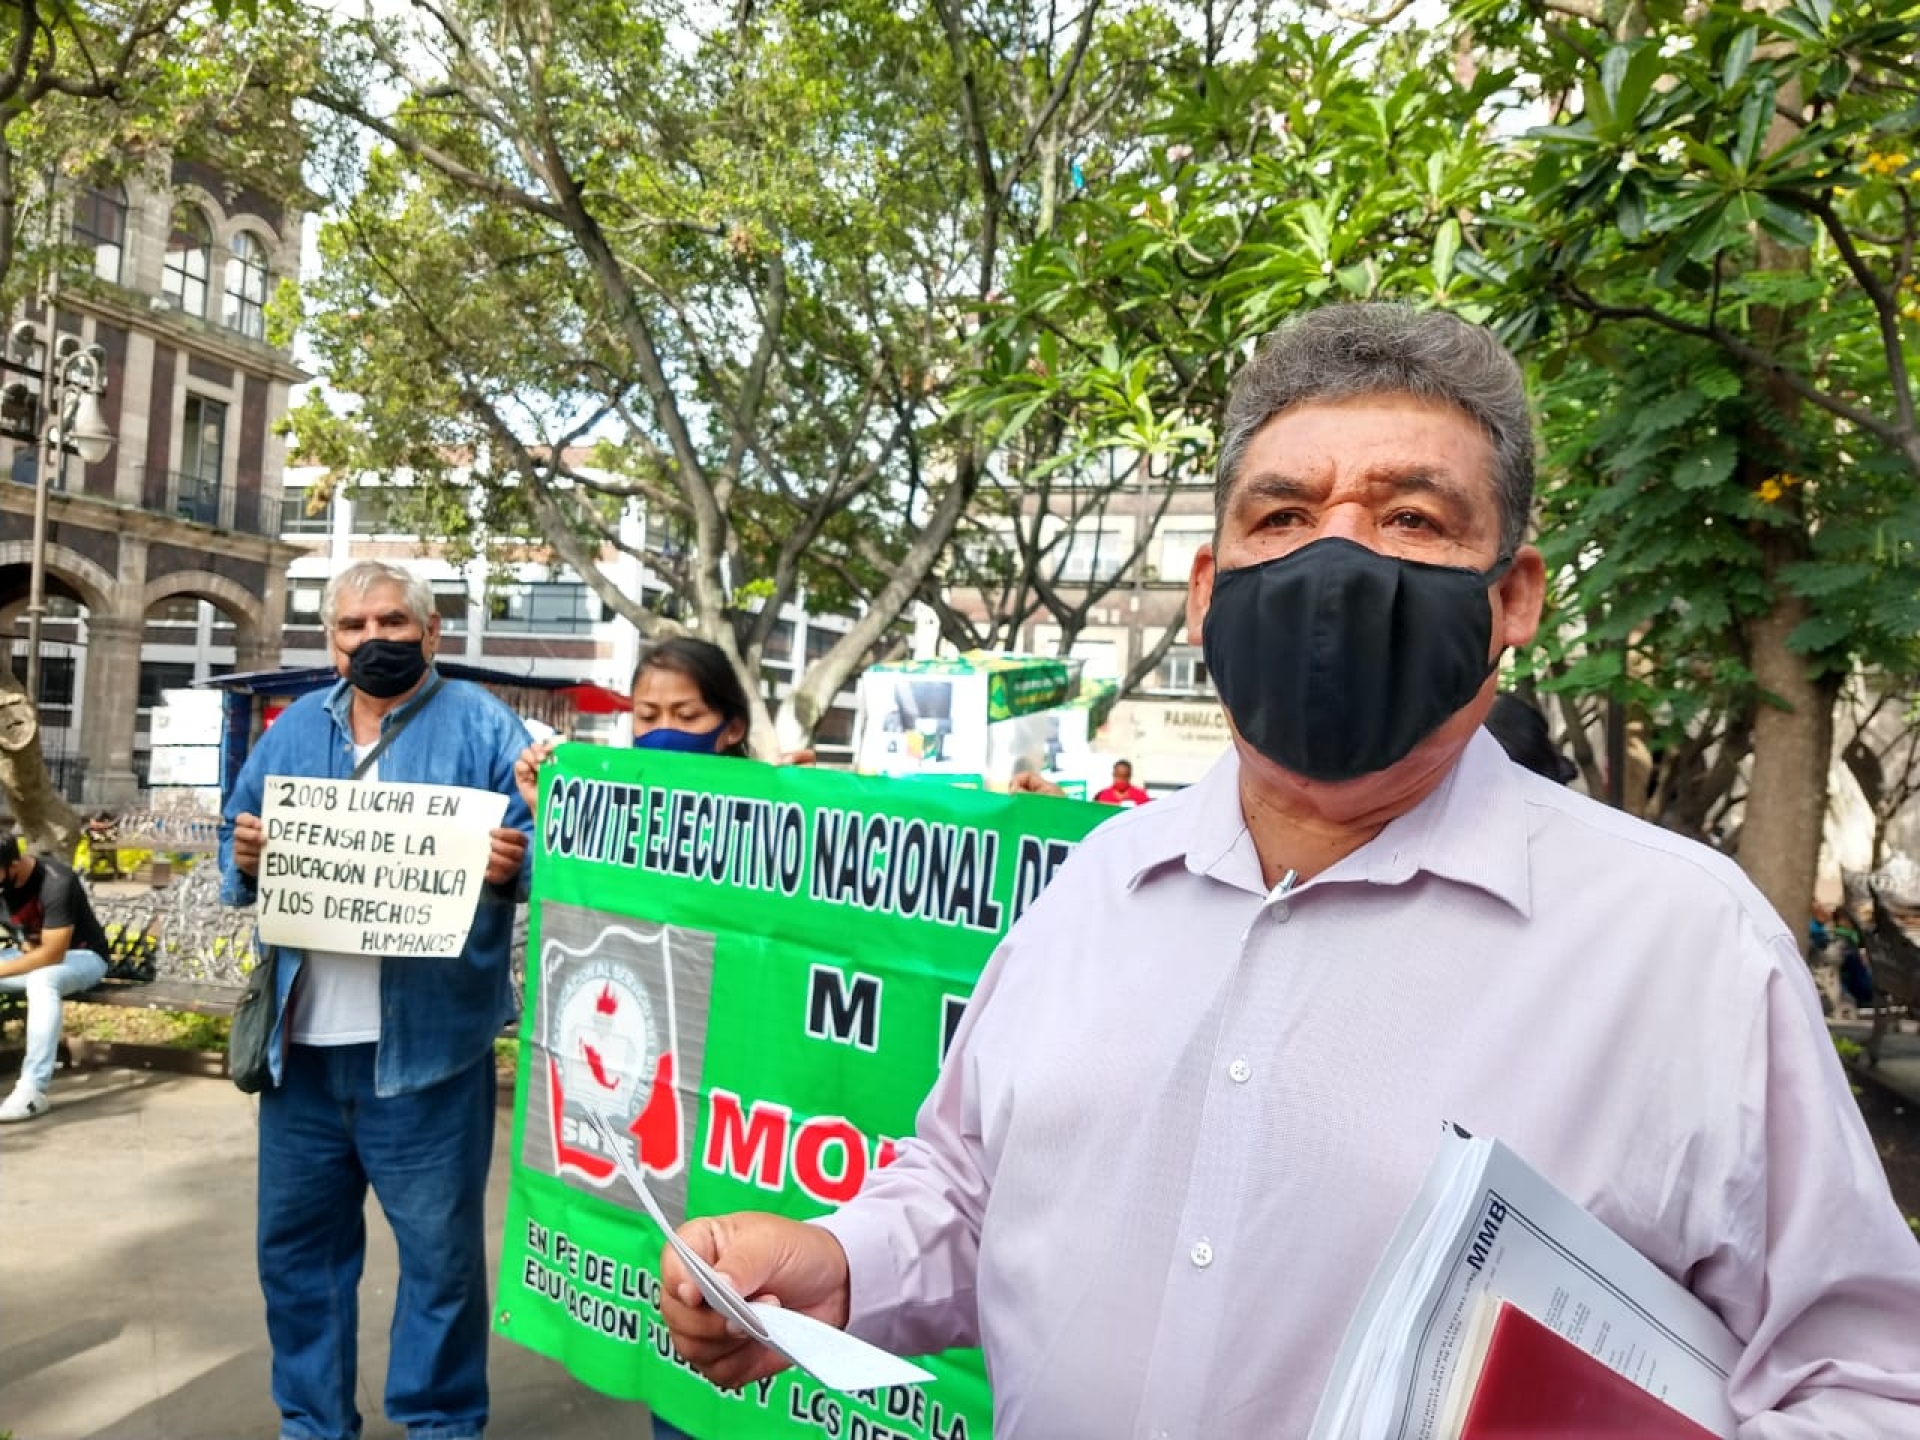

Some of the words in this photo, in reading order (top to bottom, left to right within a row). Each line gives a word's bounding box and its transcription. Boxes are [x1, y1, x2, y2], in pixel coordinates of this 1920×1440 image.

[347, 786, 415, 814] LUCHA
[426, 795, 462, 817] EN
[265, 851, 366, 885] EDUCACIÓN
[373, 861, 468, 897] PÚBLICA
[404, 834, 436, 856] LA
[546, 774, 642, 868] COMITE
[643, 787, 805, 896] EJECUTIVO
[810, 806, 1002, 933] NACIONAL
[260, 887, 274, 916] Y
[278, 890, 314, 915] LOS
[323, 895, 433, 926] DERECHOS
[703, 1087, 898, 1204] MO
[1466, 1198, 1507, 1271] MMB
[523, 1255, 641, 1343] EDUACION
[527, 1217, 549, 1257] EN
[583, 1250, 616, 1294] DE
[886, 1384, 928, 1433] DE
